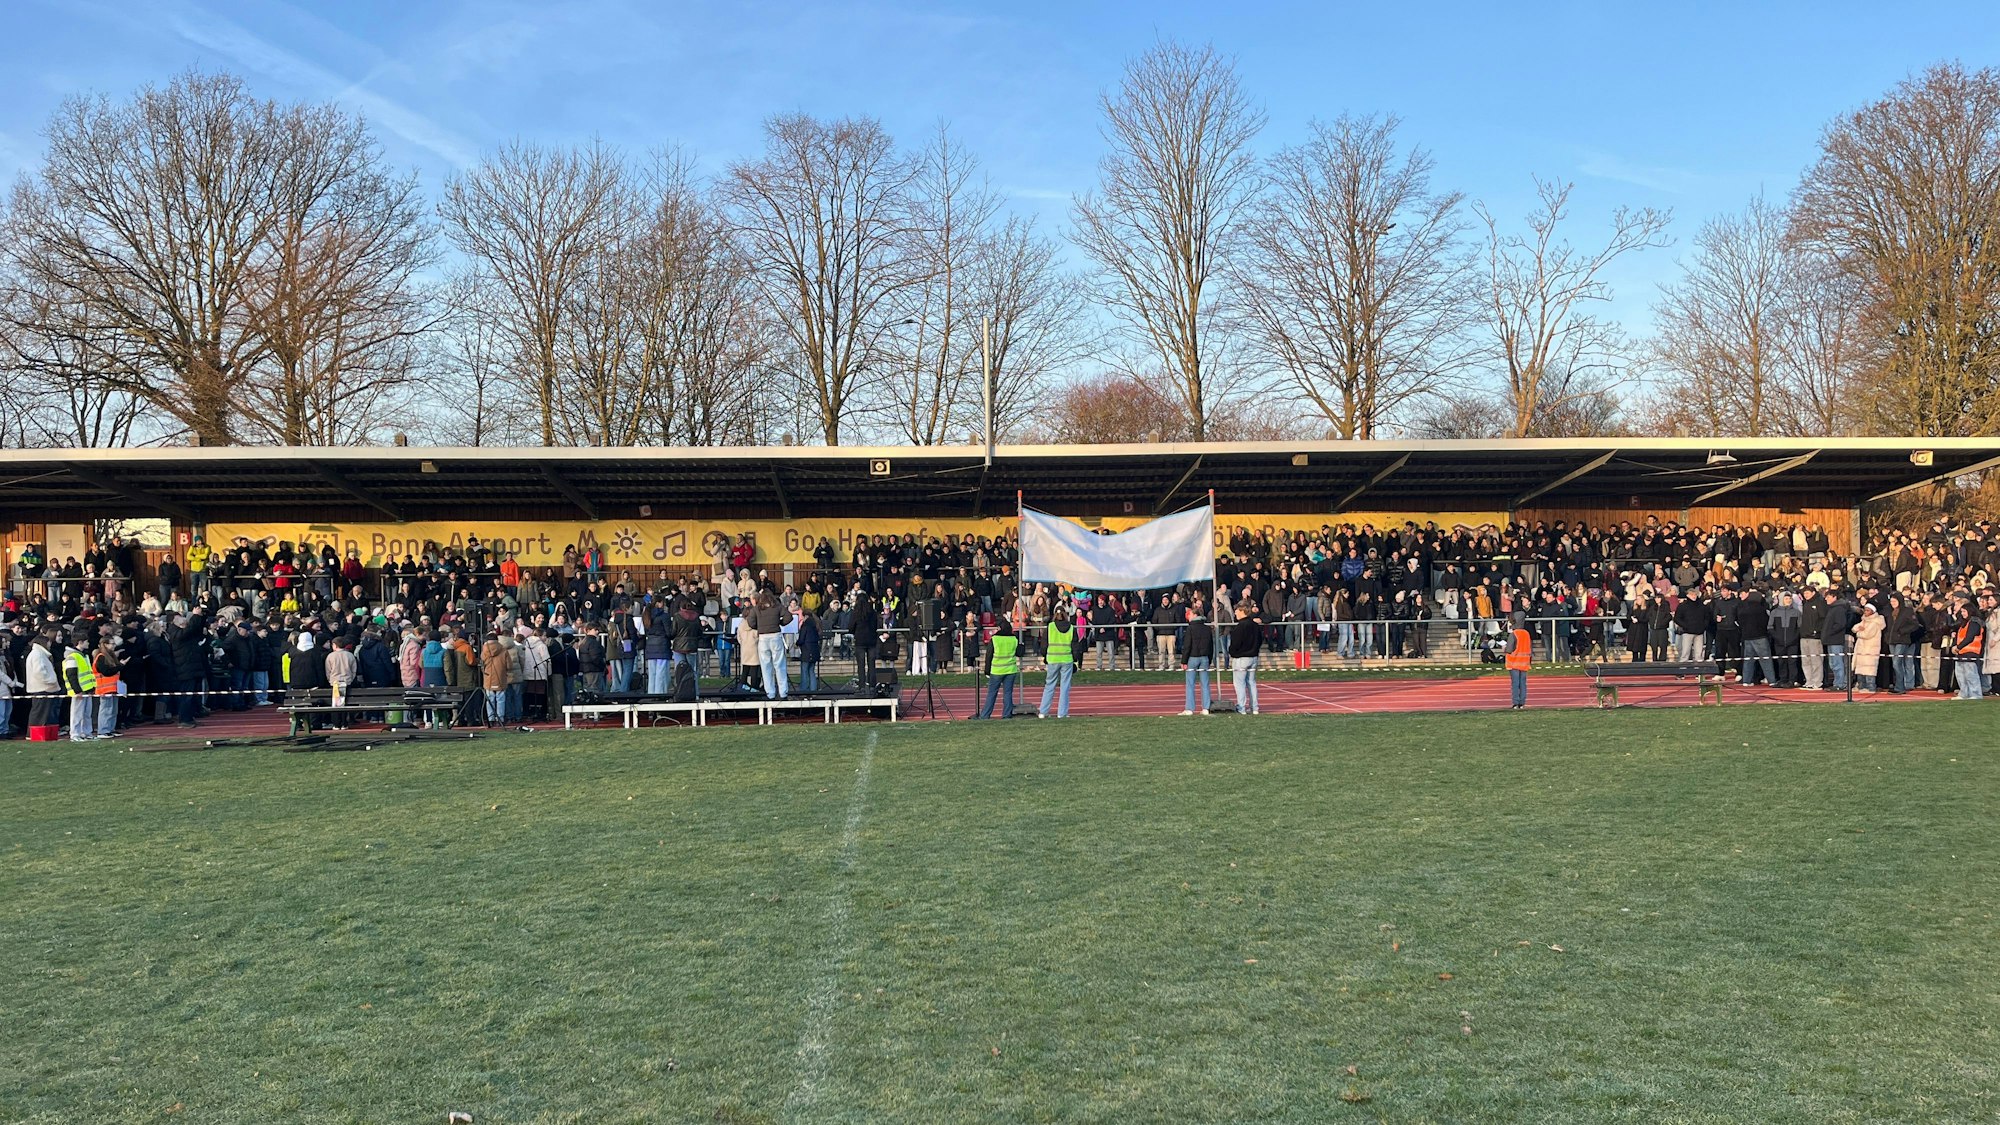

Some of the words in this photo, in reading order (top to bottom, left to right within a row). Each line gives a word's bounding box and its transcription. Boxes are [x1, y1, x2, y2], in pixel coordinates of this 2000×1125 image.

[1123, 501, 1134, 513] D
[180, 533, 189, 545] B
[372, 532, 434, 556] Bon
[785, 528, 815, 552] Go
